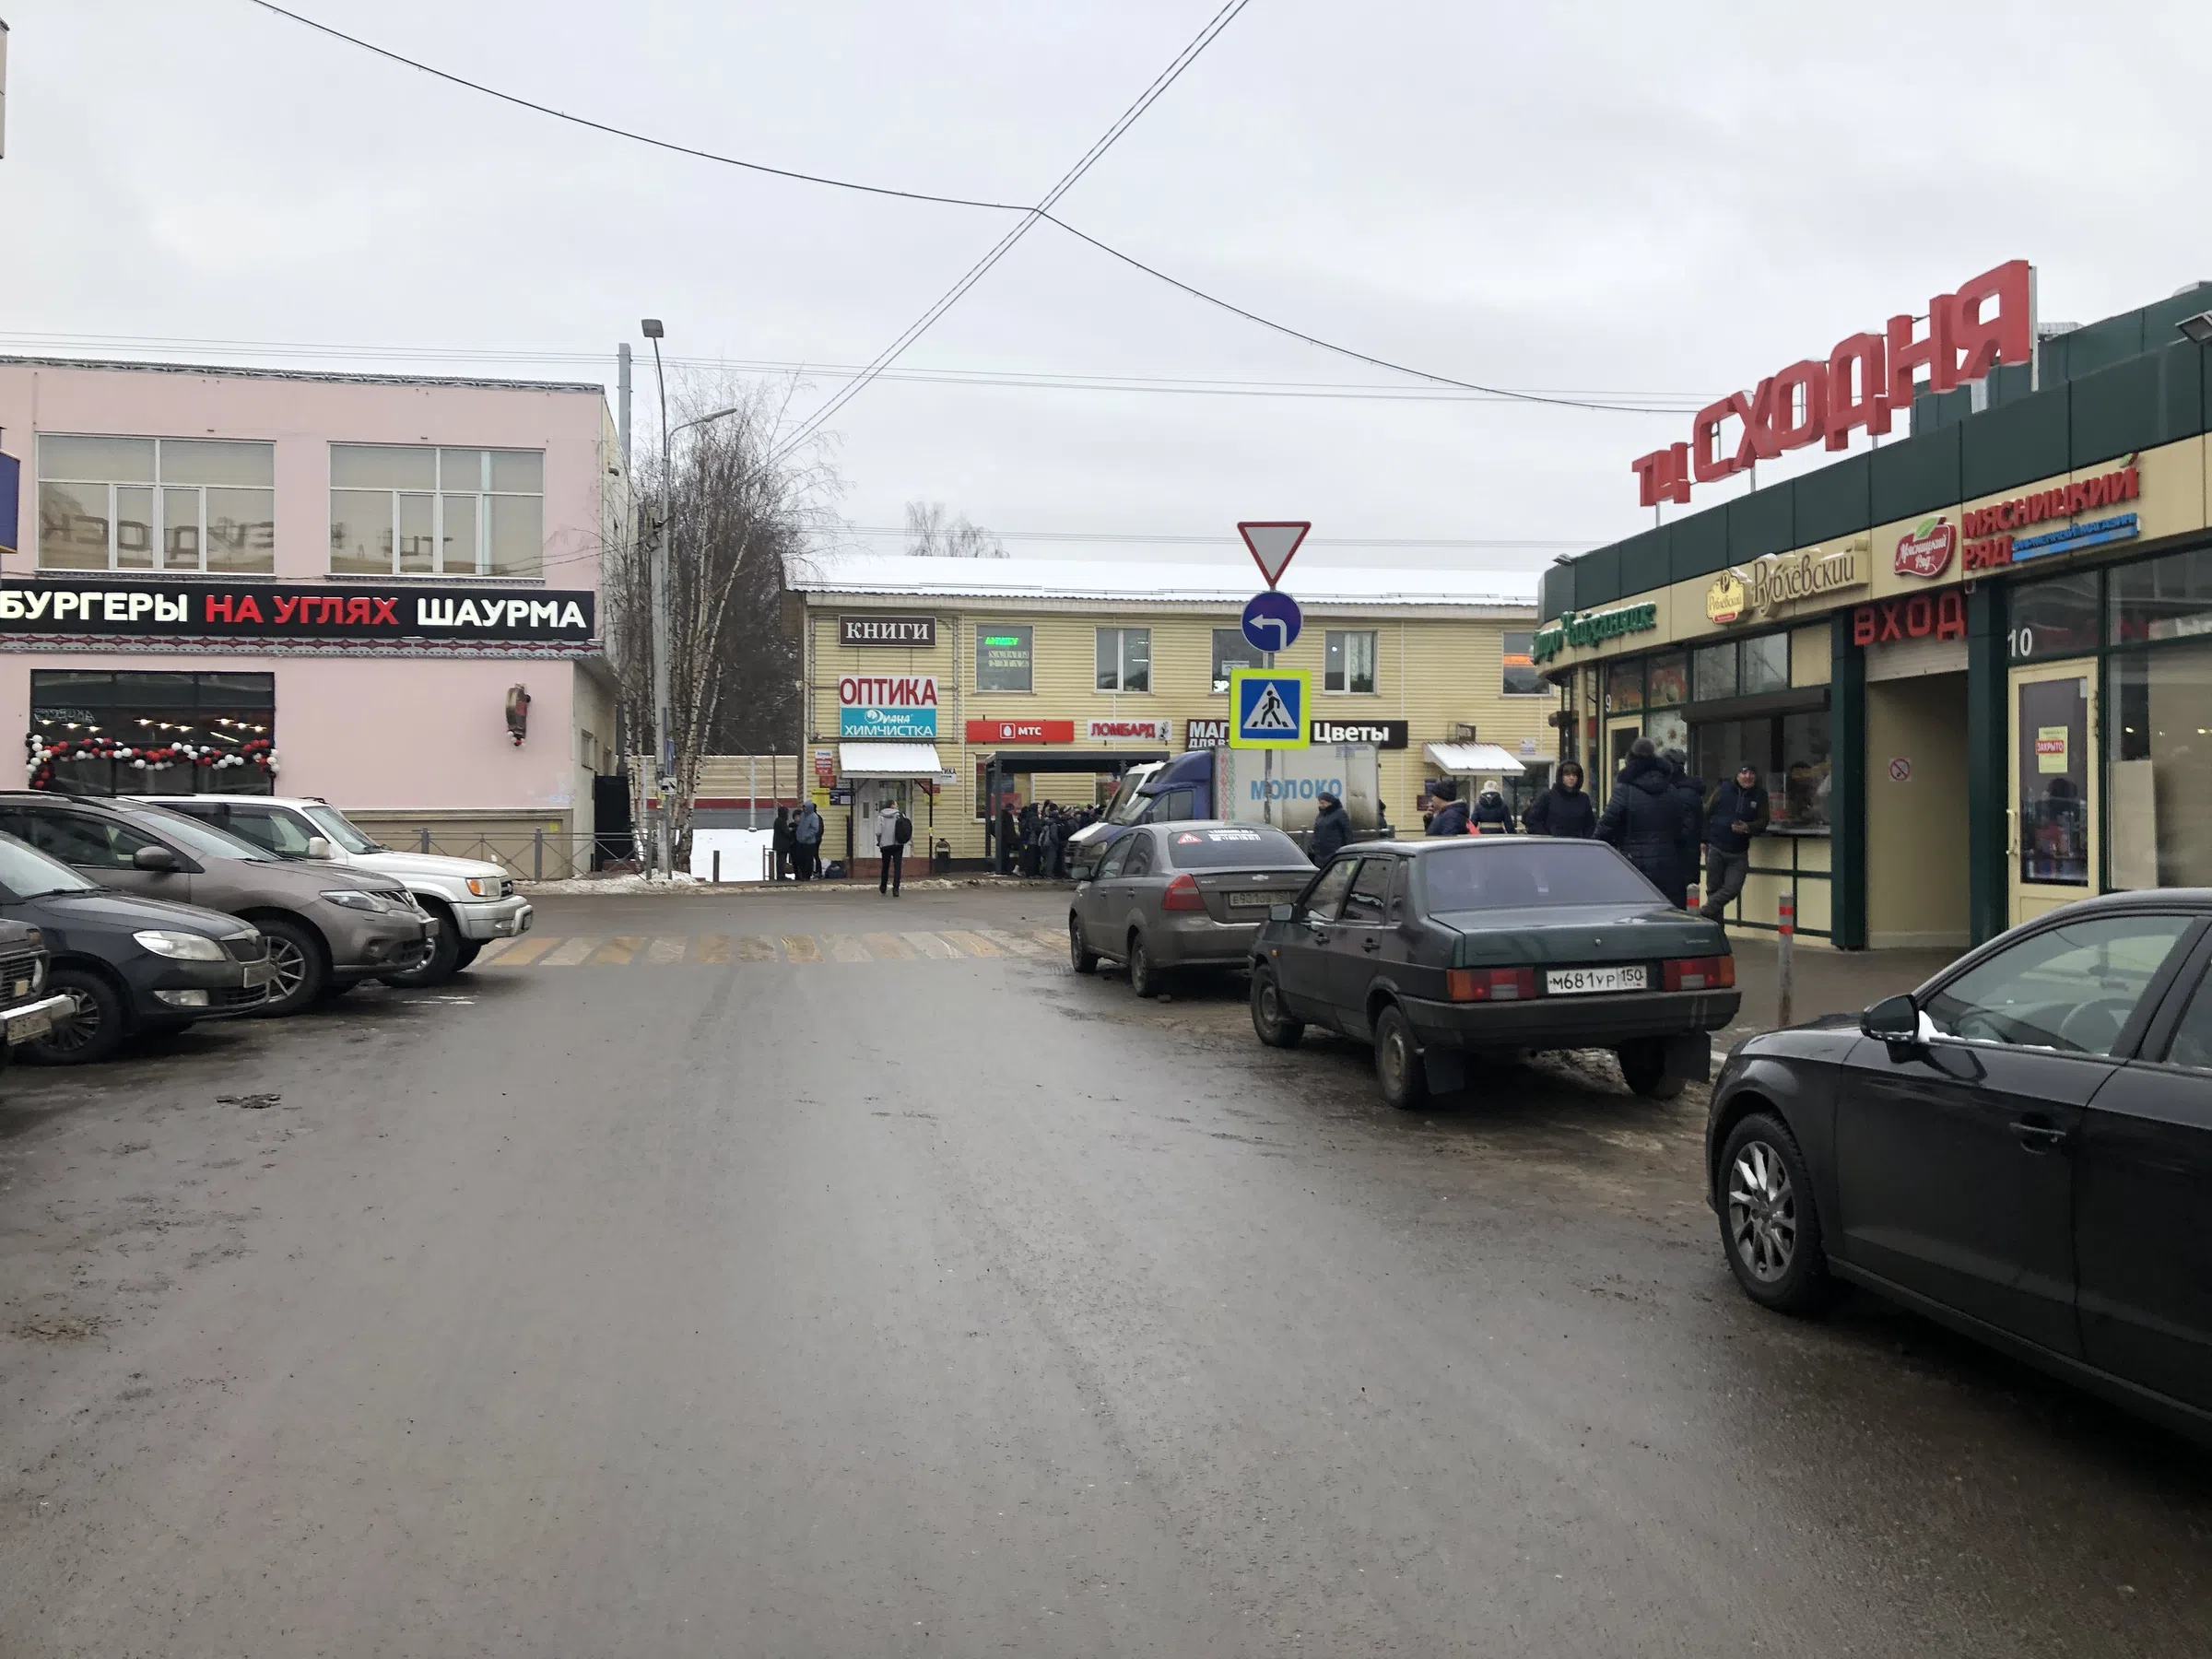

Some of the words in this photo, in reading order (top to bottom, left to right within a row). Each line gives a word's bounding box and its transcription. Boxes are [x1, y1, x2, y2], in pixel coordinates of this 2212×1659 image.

[1632, 442, 1690, 506] ТЦ
[1693, 260, 2030, 483] СХОДНЯ
[1962, 534, 2015, 571] РЯД
[0, 591, 188, 622] БУРГЕРЫ
[206, 594, 264, 623] НА
[273, 595, 399, 625] УГЛЯХ
[417, 598, 587, 629] ШАУРМА
[1854, 590, 1966, 646] ВХОД
[845, 622, 929, 640] КНИГИ
[2007, 628, 2033, 657] 10
[840, 678, 937, 705] ОПТИКА
[1606, 694, 1612, 712] 9
[844, 725, 934, 735] ХИМЧИСТКА
[1018, 726, 1042, 735] МТС
[1091, 723, 1156, 737] ЛОМБАРД
[1190, 722, 1230, 738] МАГ
[1313, 723, 1389, 743] Цветы
[2037, 741, 2064, 753] ЗАКРЫТО
[1251, 779, 1343, 801] МОЛОКО
[1621, 969, 1643, 982] 150
